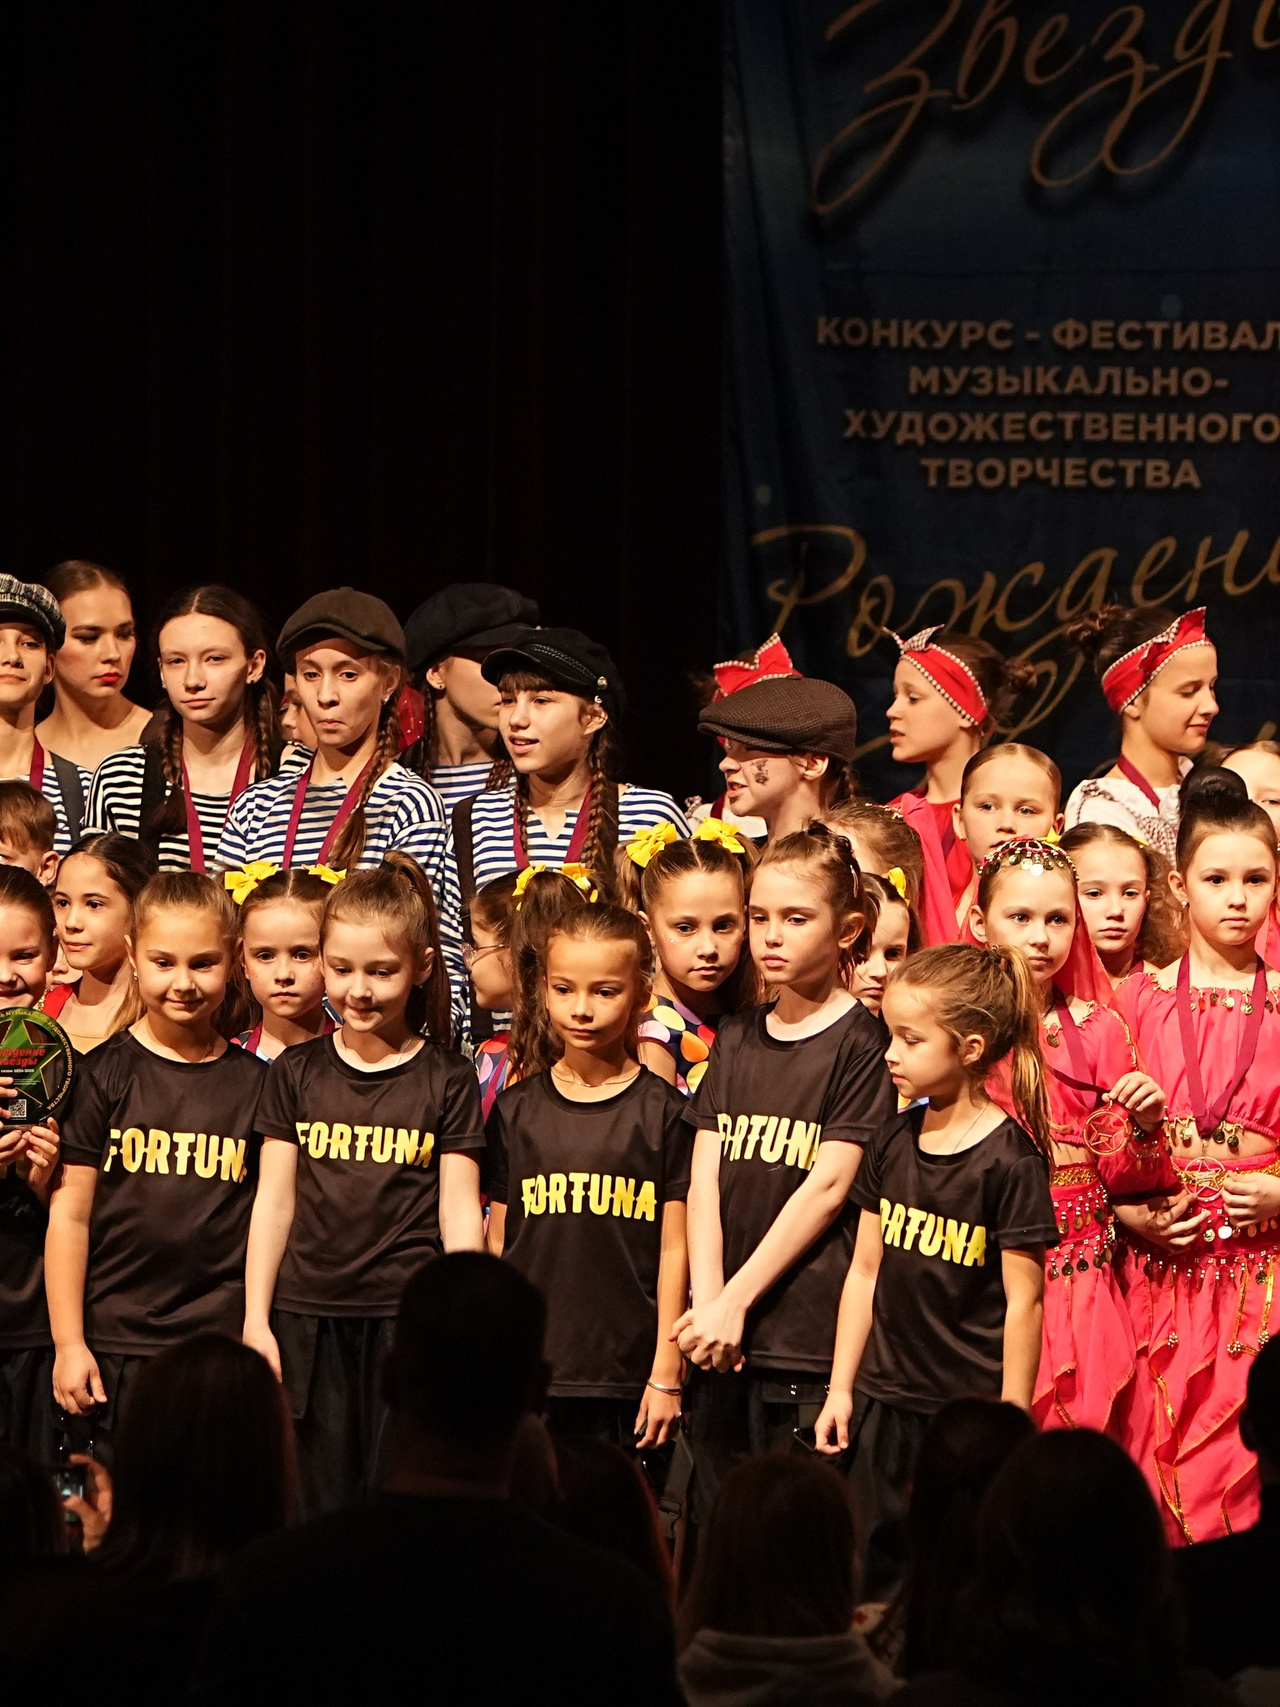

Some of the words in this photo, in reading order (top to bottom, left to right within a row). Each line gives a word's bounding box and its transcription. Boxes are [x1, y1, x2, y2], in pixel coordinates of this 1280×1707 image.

[815, 317, 1014, 350] КОНКУРС
[908, 365, 1230, 397] МУЗЫКАЛЬНО-
[842, 409, 1280, 446] ХУДОЖЕСТВЕННОГО
[921, 457, 1202, 489] ТВОРЧЕСТВА
[750, 523, 1280, 741] Рожден
[104, 1127, 248, 1183] FORTUN
[295, 1121, 435, 1166] FORTUNA
[521, 1171, 658, 1222] FORTUNA
